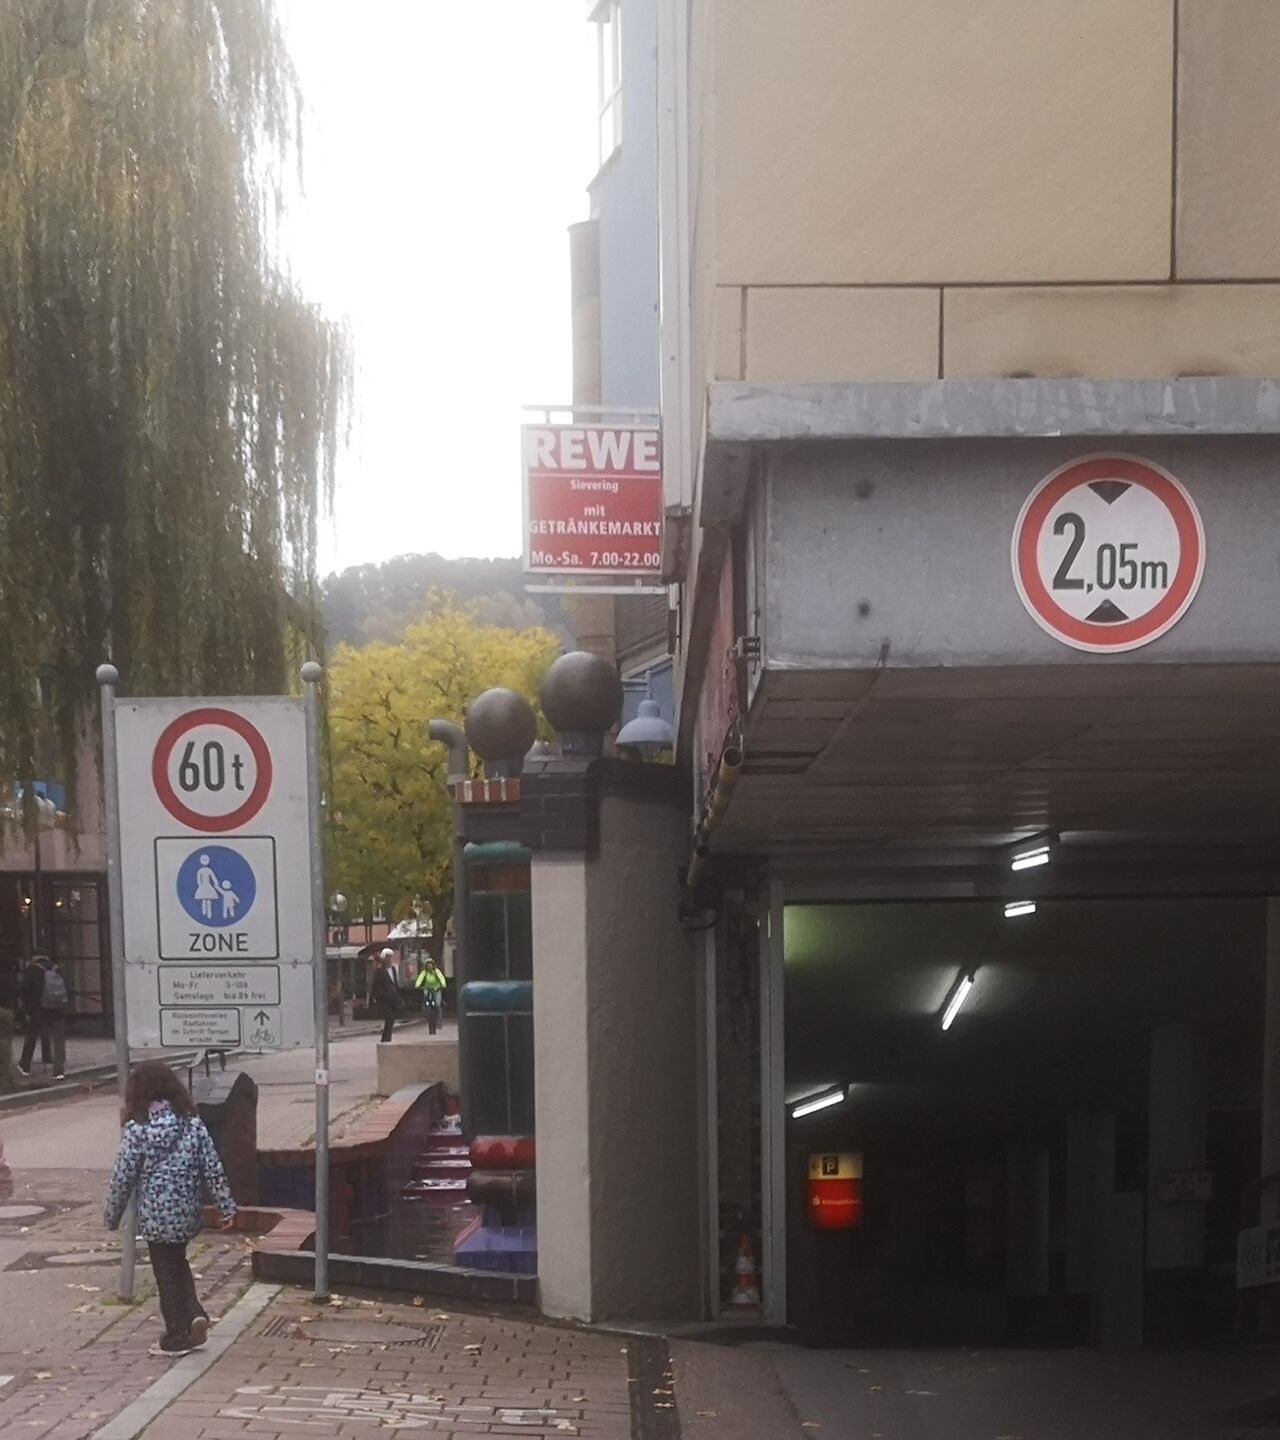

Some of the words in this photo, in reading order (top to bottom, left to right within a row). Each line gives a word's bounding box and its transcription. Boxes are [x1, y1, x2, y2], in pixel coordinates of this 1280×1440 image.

[528, 430, 660, 471] REWE
[570, 479, 619, 493] Sievering
[584, 504, 606, 517] mit
[529, 517, 661, 536] GETRÄNKEMARKT
[531, 552, 583, 566] Mo.-Sa.
[591, 551, 660, 567] 7.00-22.00
[189, 932, 249, 952] ZONE
